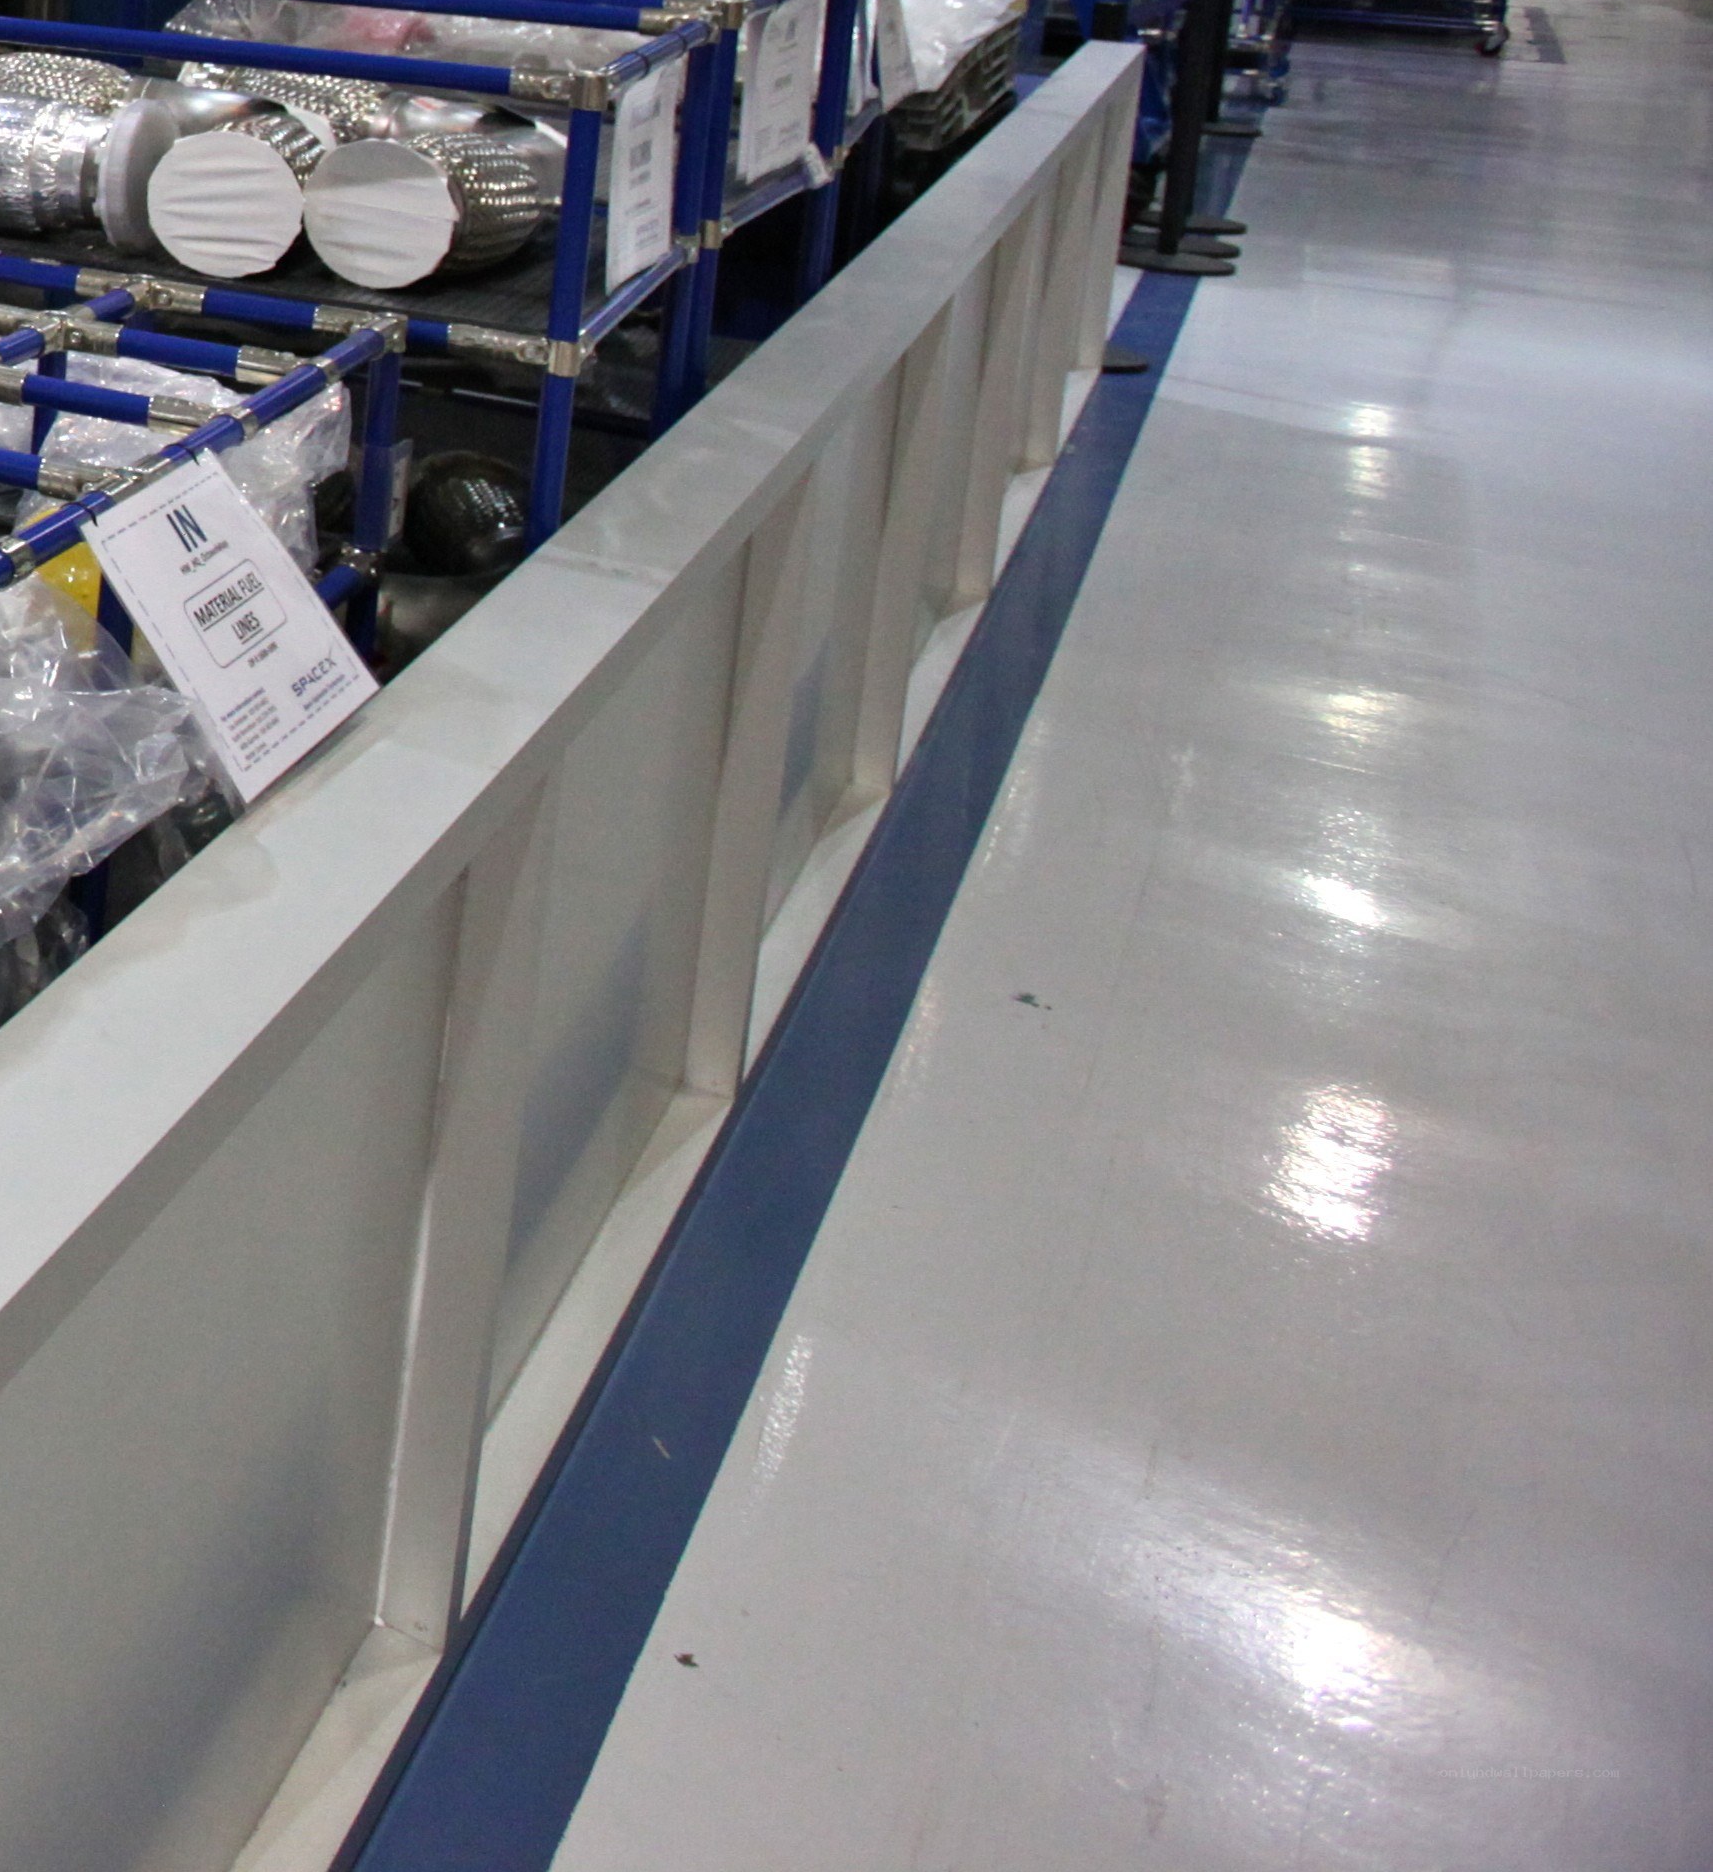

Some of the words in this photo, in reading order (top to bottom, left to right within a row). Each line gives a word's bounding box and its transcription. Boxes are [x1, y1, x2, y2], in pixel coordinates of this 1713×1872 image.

[193, 585, 242, 628] MATERIAL
[237, 571, 263, 596] FUEL
[231, 610, 261, 640] LINES
[291, 652, 337, 697] SPACEX
